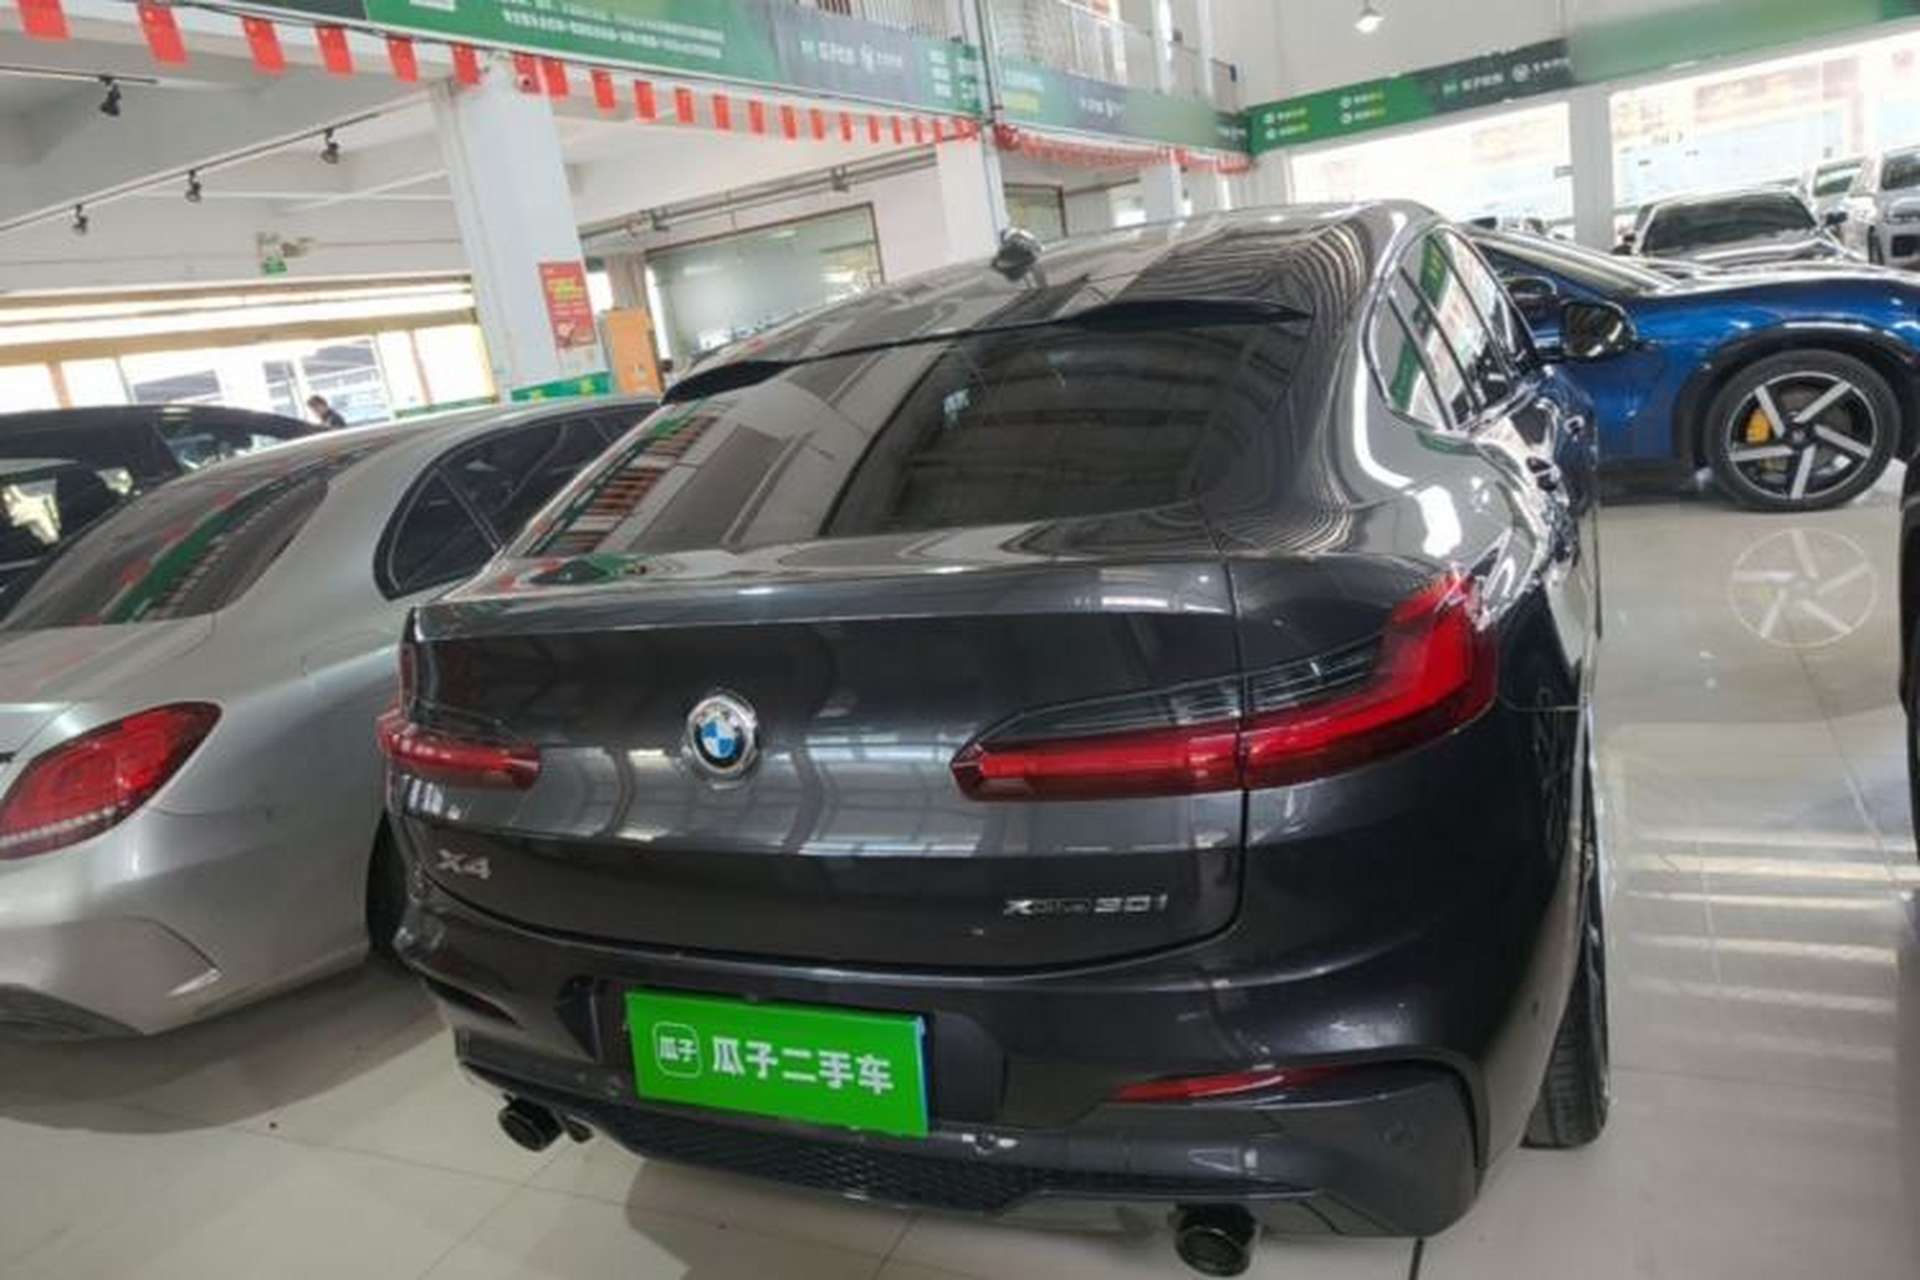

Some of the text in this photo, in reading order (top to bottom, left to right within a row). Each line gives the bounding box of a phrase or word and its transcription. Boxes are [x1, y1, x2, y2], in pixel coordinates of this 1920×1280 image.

[438, 848, 489, 879] X4
[711, 1035, 894, 1094] 瓜子二手车
